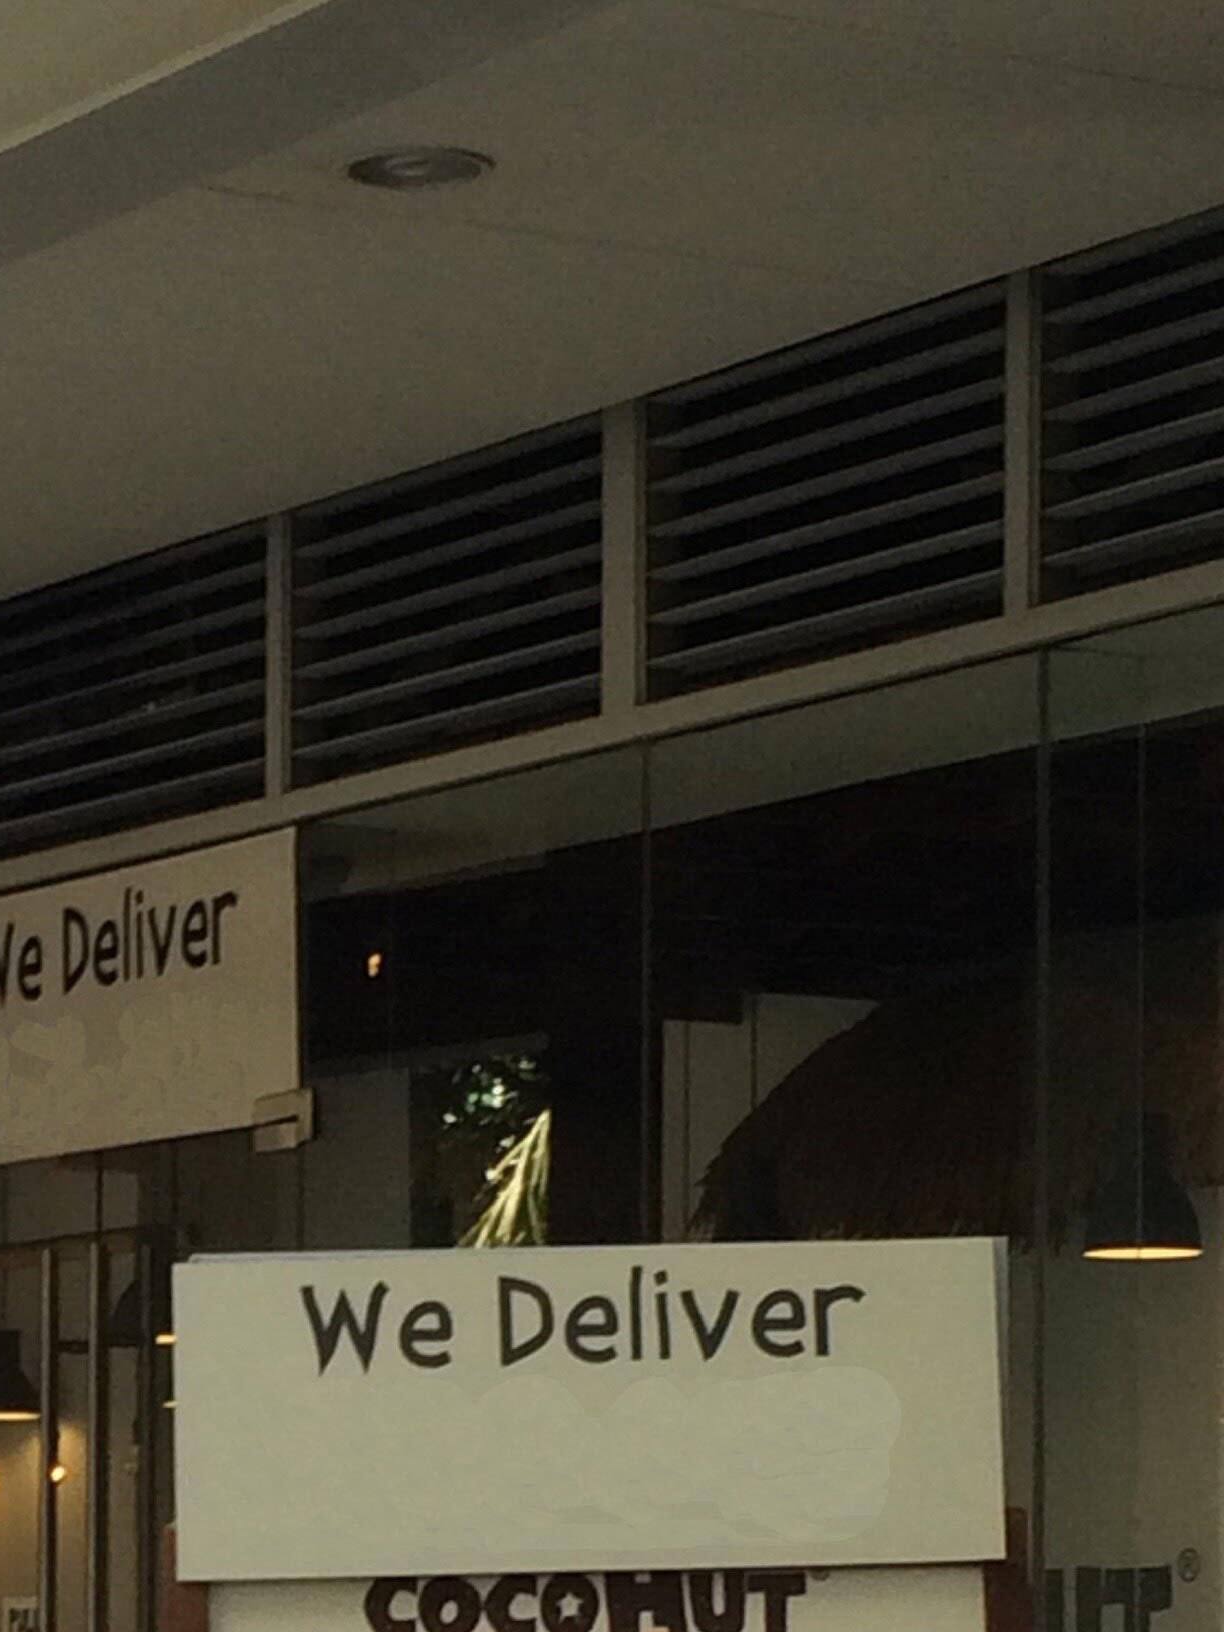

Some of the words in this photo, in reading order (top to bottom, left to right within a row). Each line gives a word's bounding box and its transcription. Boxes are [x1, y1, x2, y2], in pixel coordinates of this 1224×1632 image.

[63, 887, 238, 995] Deliver
[300, 1280, 453, 1376] We
[499, 1267, 866, 1366] Deliver
